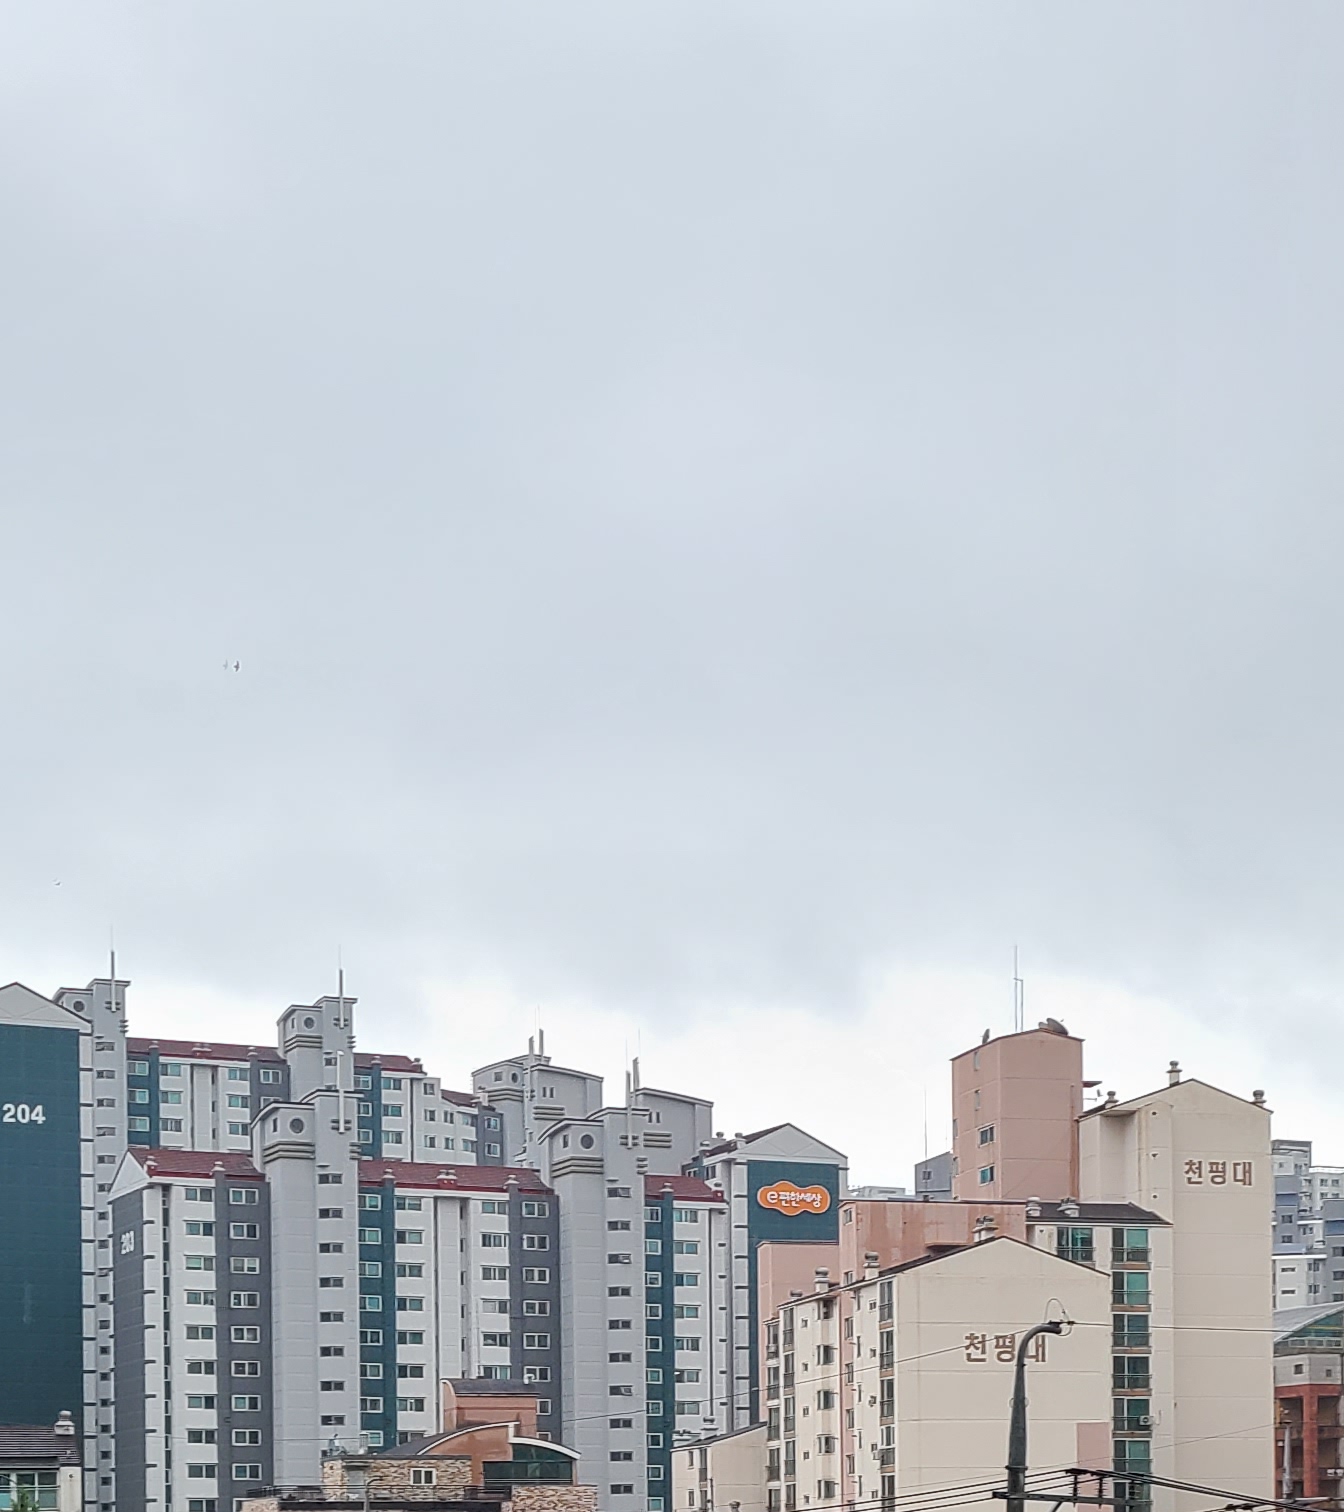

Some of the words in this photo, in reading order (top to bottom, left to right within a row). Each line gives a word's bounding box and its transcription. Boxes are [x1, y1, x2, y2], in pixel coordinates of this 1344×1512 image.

[2, 1103, 46, 1124] 204
[1184, 1160, 1253, 1186] 천평대
[766, 1191, 823, 1208] e편한세상
[964, 1332, 1046, 1363] 천평대
